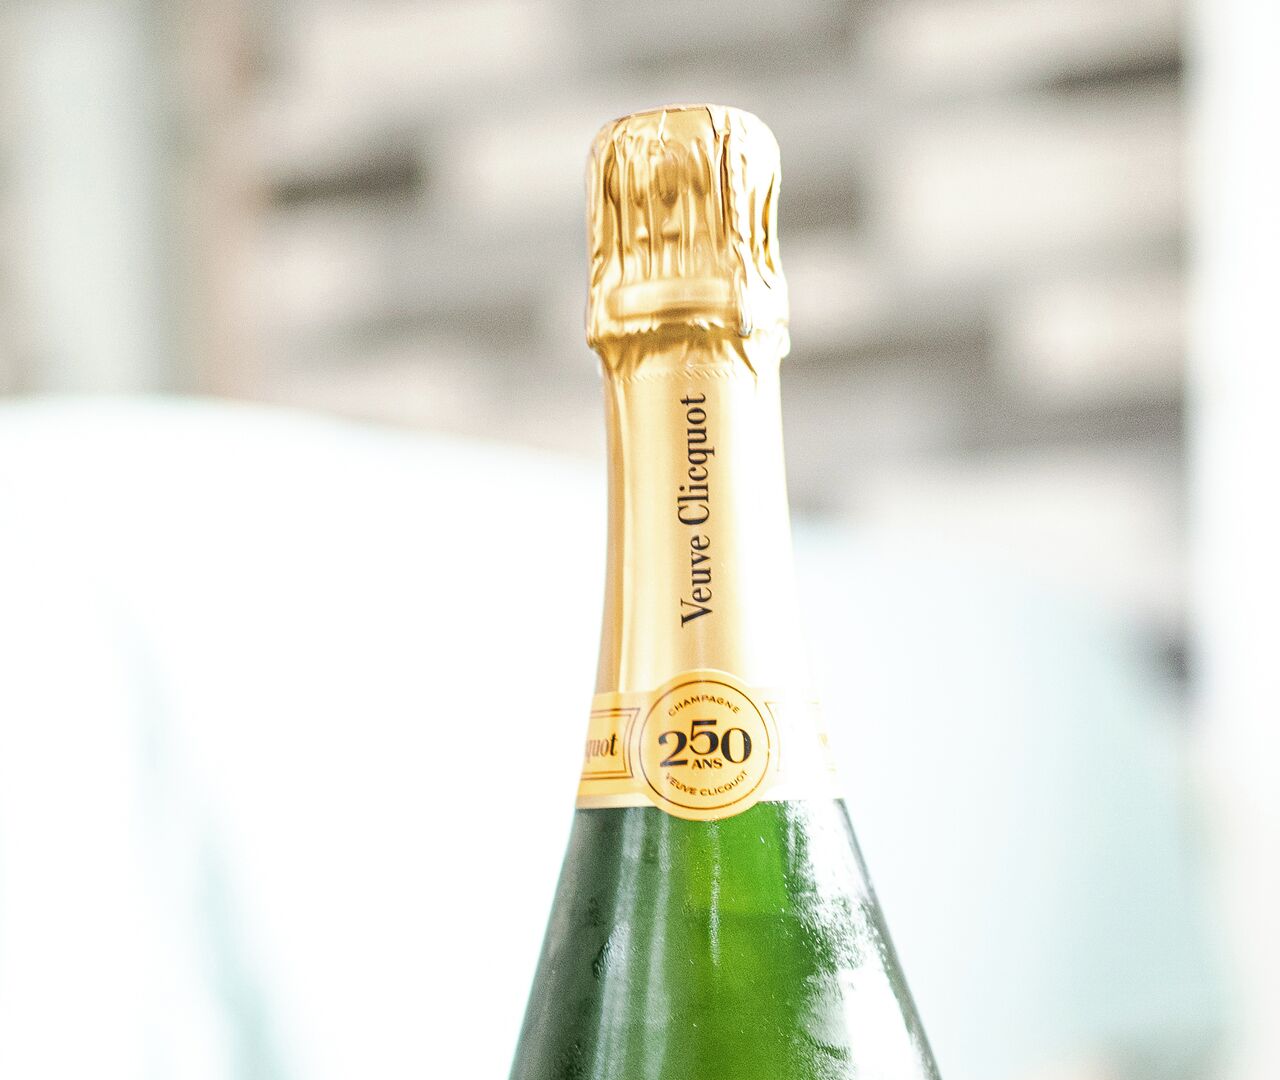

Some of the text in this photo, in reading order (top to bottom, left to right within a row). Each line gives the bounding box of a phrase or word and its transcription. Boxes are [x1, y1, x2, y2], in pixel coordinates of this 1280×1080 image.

[677, 392, 715, 628] Veuve Clicquot
[668, 694, 740, 717] CHAMPAGNE
[658, 719, 753, 768] 250
[691, 757, 723, 770] ANS
[665, 769, 749, 796] VEUVE CLICQUOT
